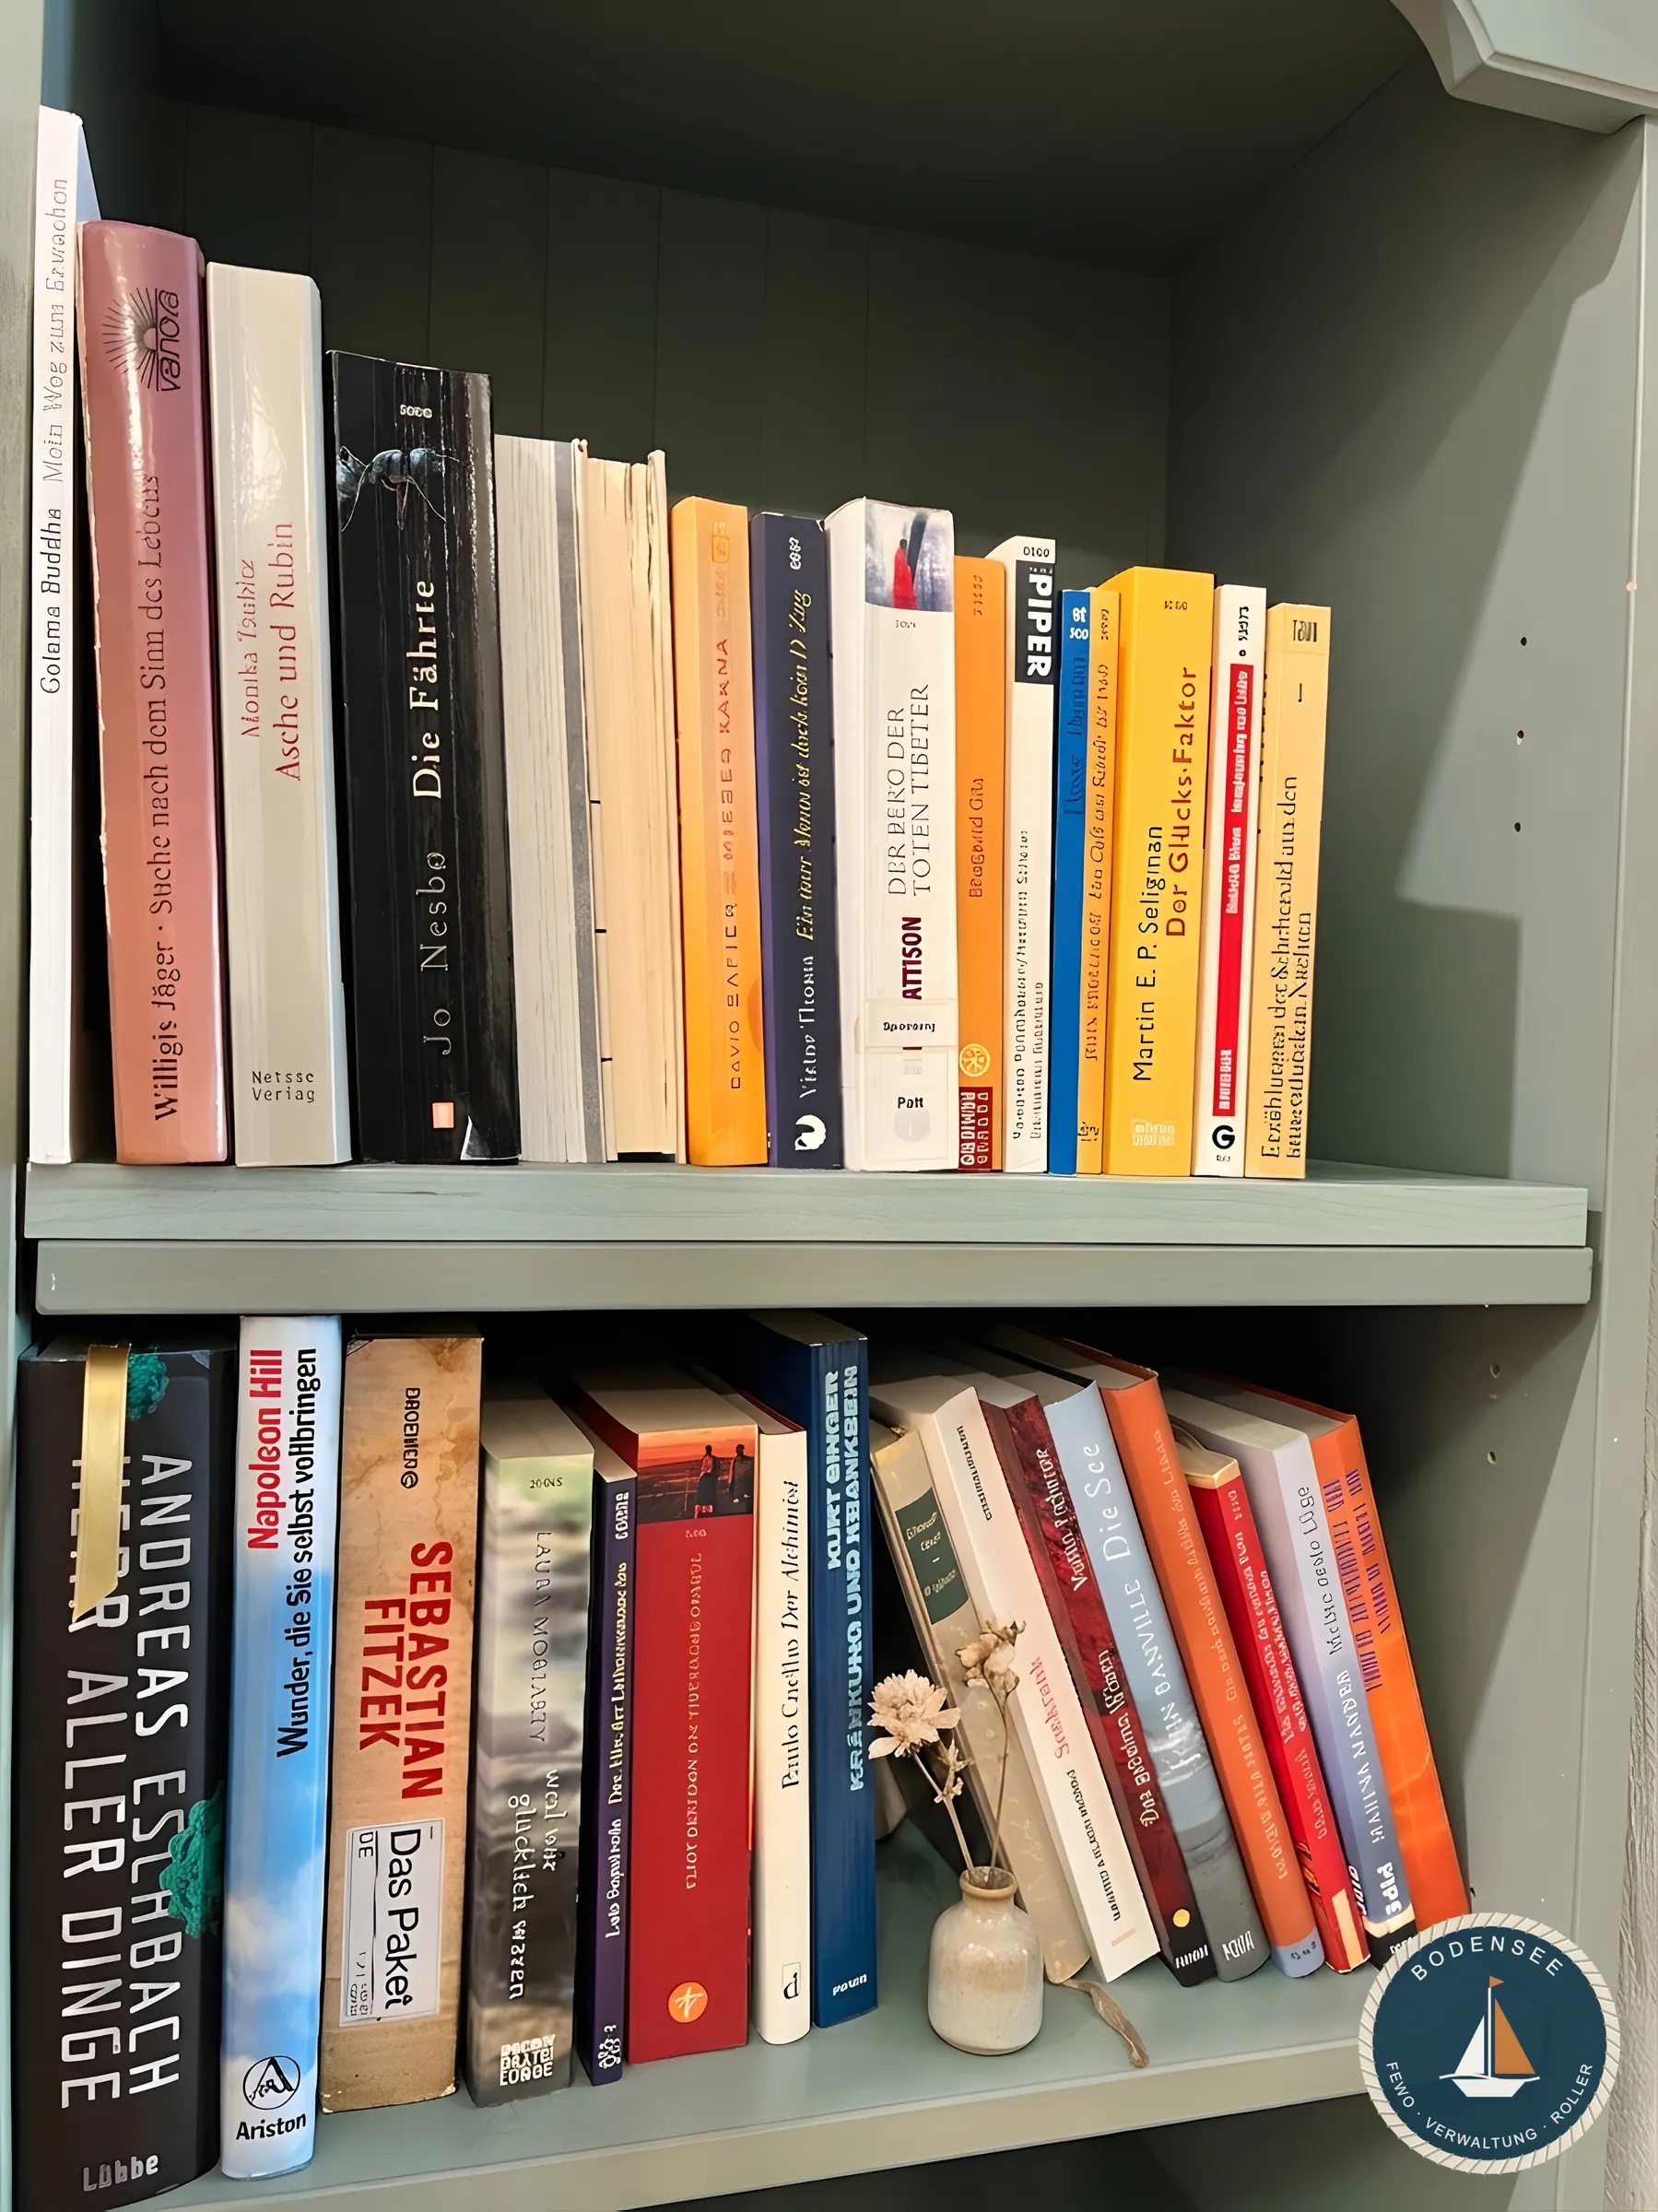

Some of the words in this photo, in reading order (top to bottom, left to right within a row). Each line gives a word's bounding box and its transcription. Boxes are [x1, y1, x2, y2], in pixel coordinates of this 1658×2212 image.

[266, 523, 296, 608] Rubin
[1026, 572, 1052, 677] PIPER
[411, 733, 442, 800] Die
[900, 916, 923, 1000] ATTISON
[1133, 1001, 1158, 1082] Martin
[249, 1348, 283, 1398] Hill
[246, 1406, 288, 1550] Napoleon
[135, 1453, 193, 1737] ANDREAS
[285, 1606, 312, 1649] die
[286, 1568, 312, 1608] Sie
[276, 1651, 313, 1758] Wunder,
[358, 1597, 406, 1750] FITZEK
[401, 1541, 454, 1800] SEBASTIAN
[63, 1669, 130, 1879] ALLER
[388, 1828, 421, 1899] Das
[61, 1906, 123, 2109] DINGE
[235, 2113, 308, 2142] Ariston
